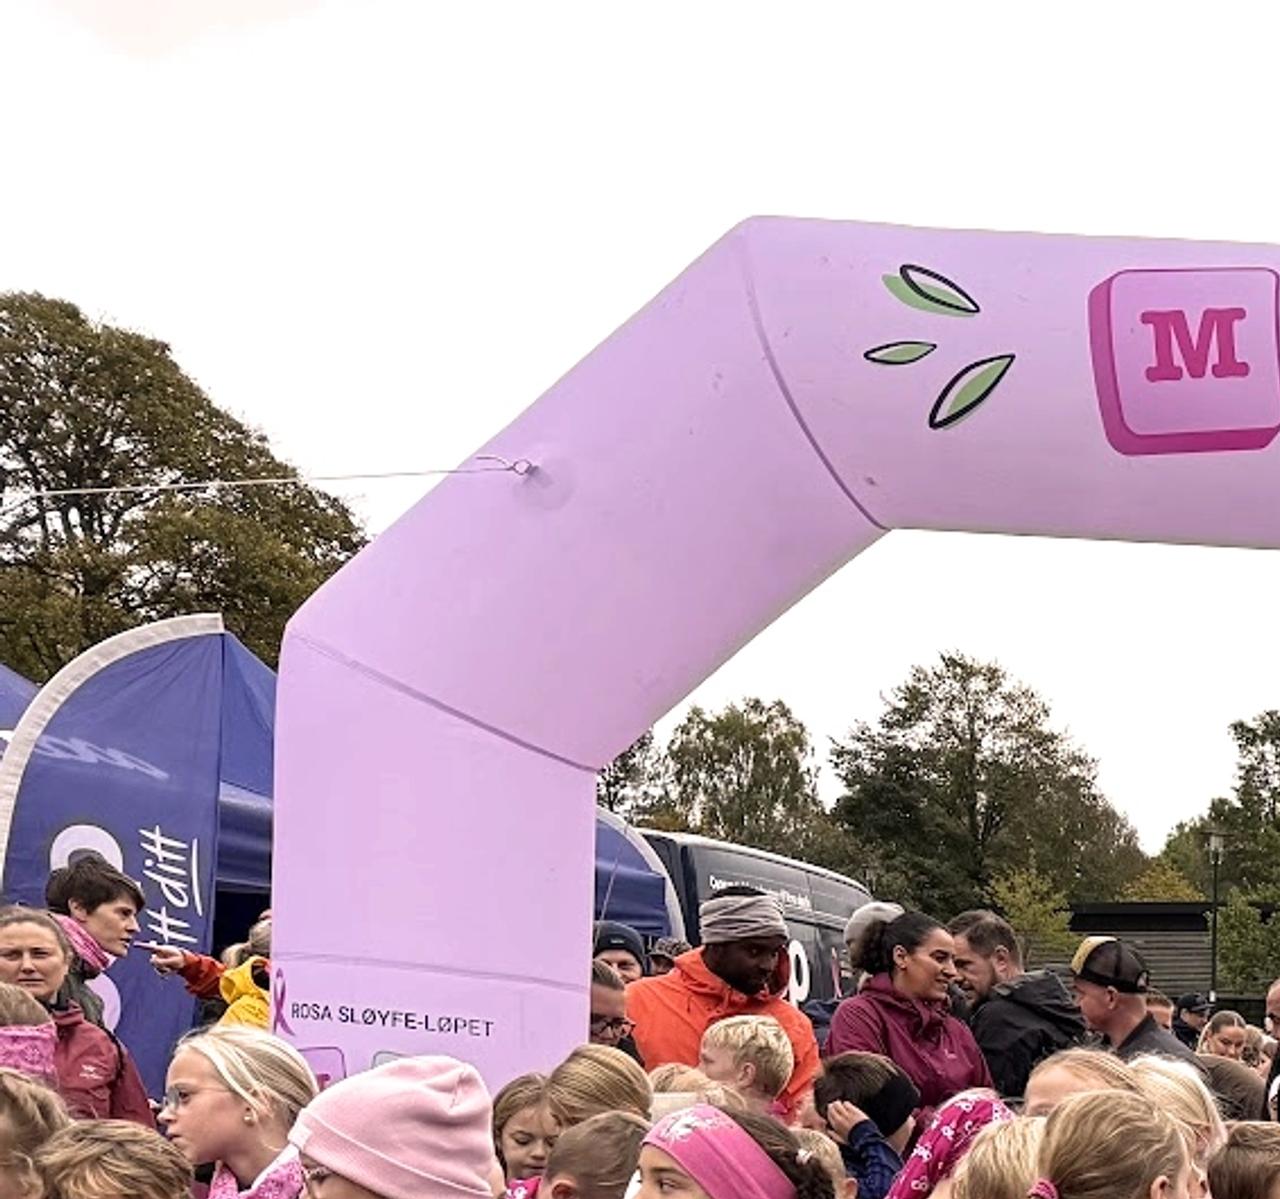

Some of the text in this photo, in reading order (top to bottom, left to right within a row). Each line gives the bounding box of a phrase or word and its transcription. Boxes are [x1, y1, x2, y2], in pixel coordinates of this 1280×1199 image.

[138, 825, 189, 909] ditt
[291, 1003, 494, 1037] ROSA SLØYFE-LØPET
